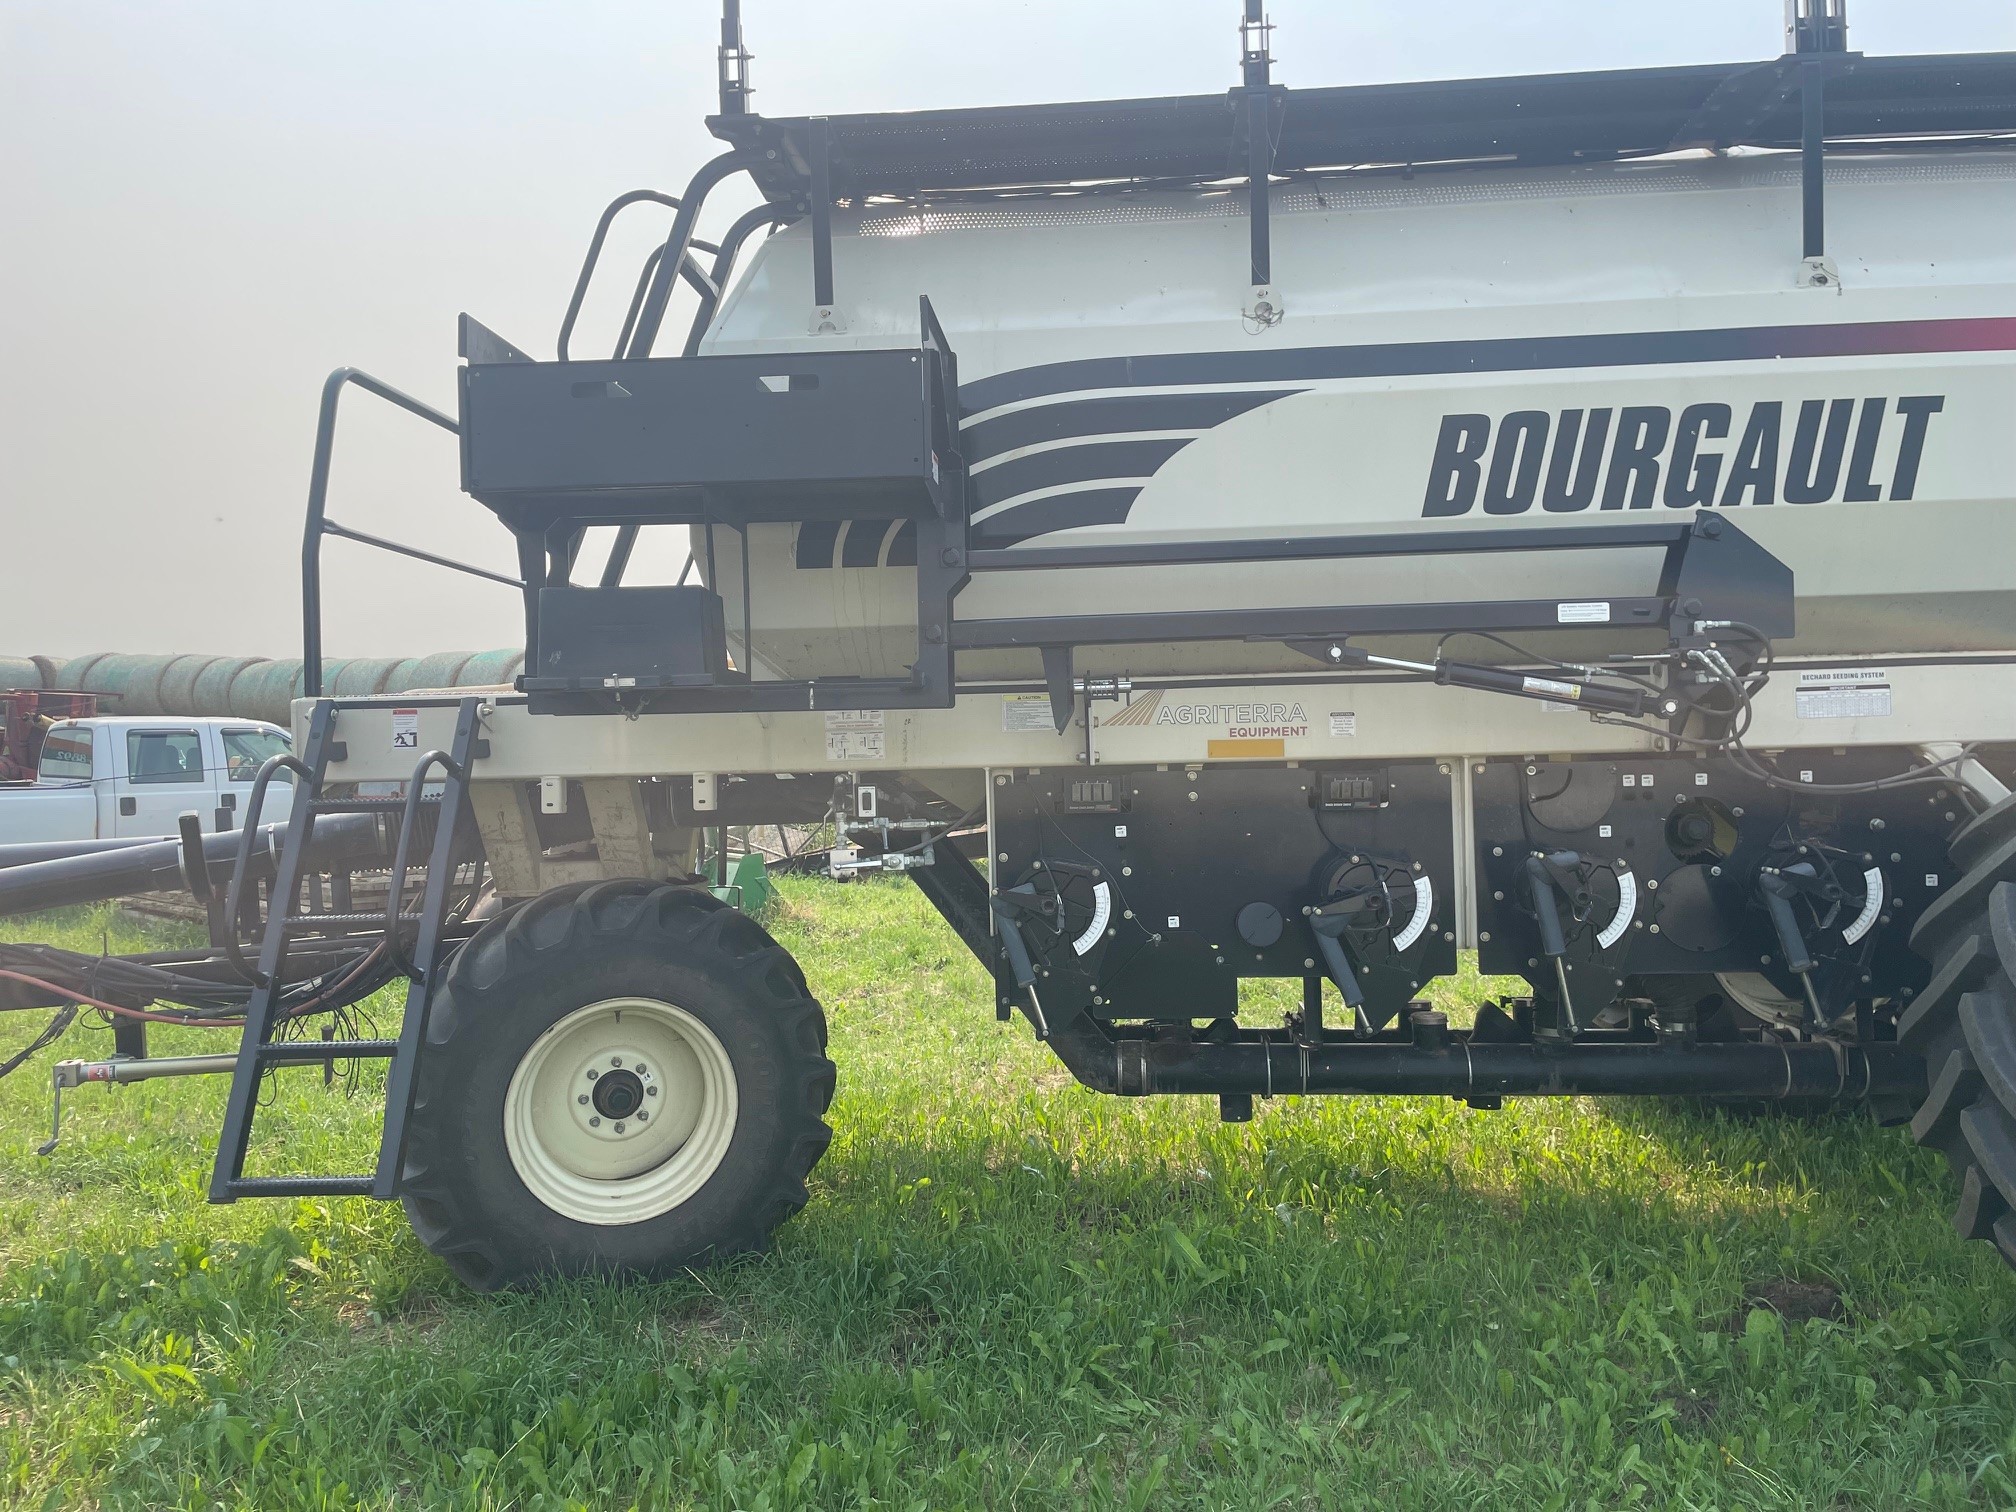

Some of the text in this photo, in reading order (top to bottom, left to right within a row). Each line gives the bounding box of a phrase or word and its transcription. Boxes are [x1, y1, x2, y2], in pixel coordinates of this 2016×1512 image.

[1421, 395, 1945, 518] BOURGAULT
[1156, 702, 1308, 726] AGRITERRA
[1229, 726, 1308, 738] EQUIPMENT
